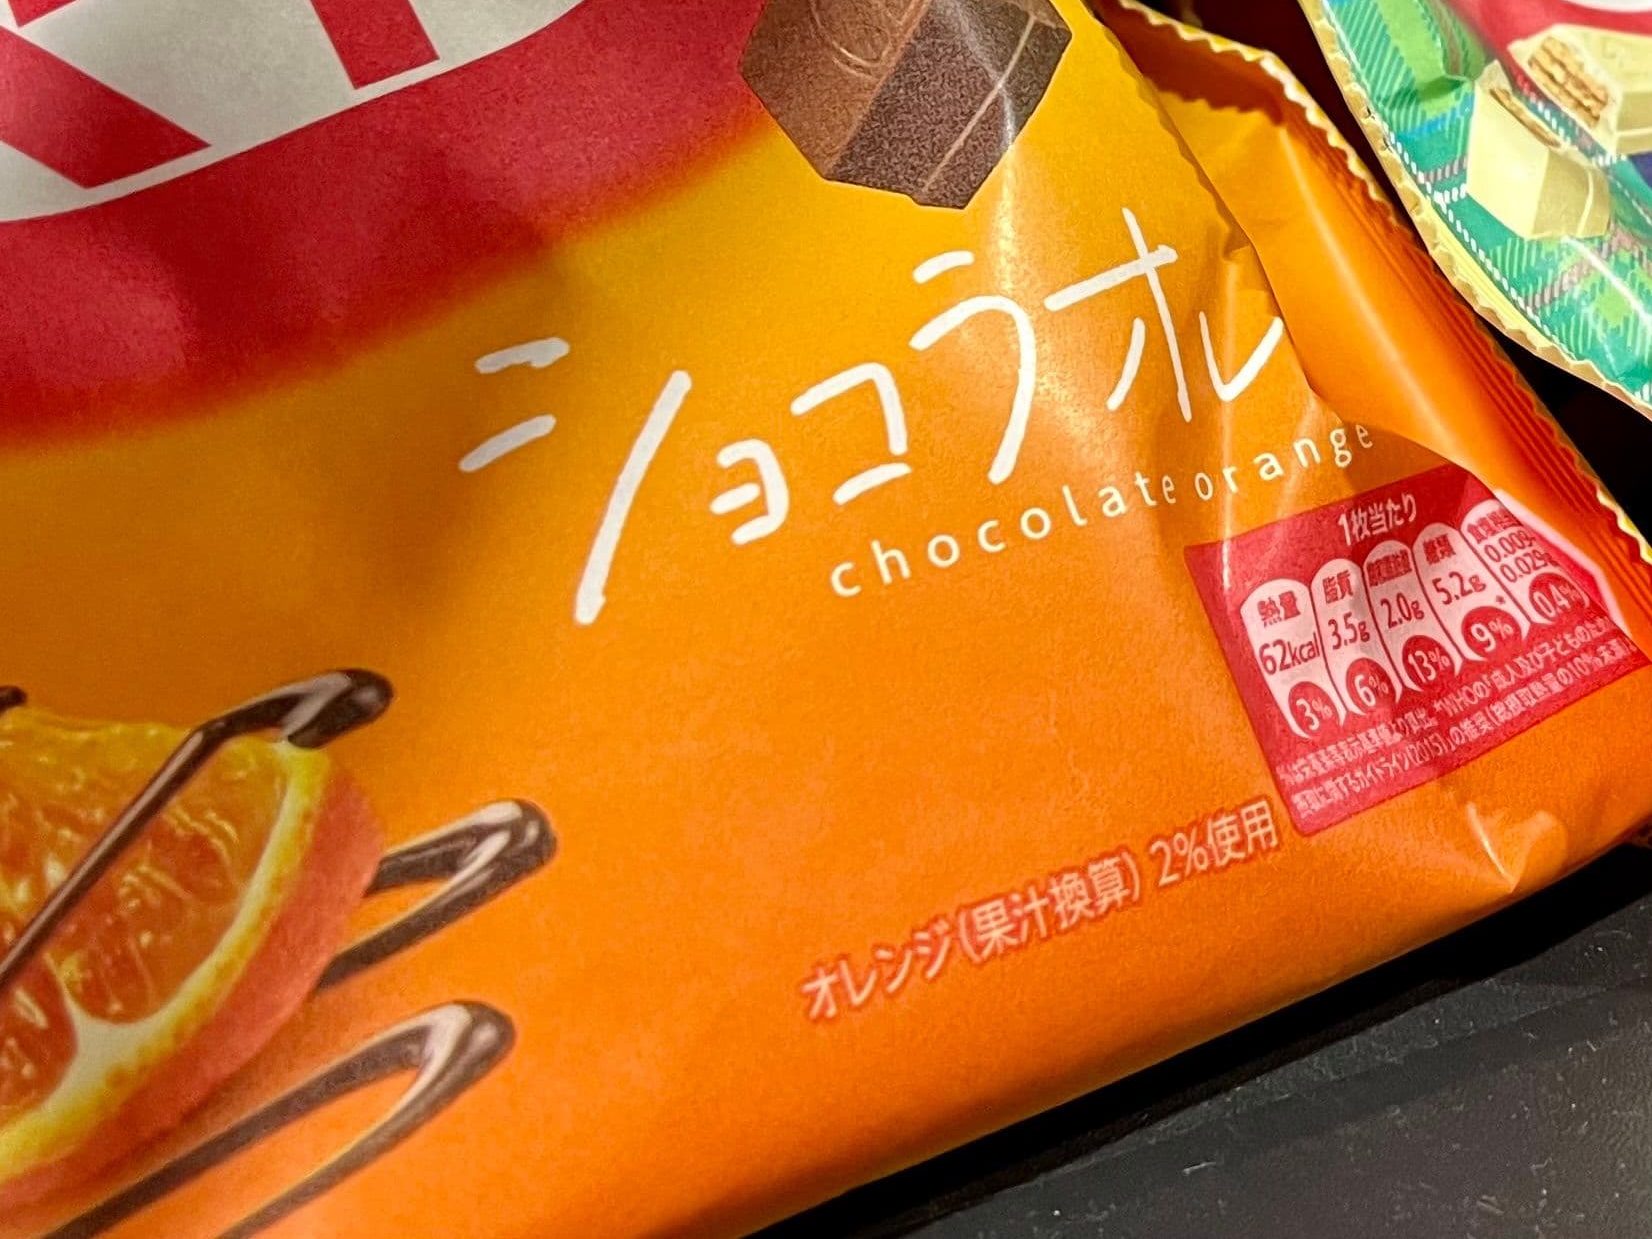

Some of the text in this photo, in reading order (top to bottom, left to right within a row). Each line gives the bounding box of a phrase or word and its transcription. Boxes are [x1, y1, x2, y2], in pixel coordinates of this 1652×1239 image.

[458, 208, 1285, 624] ショコラオレ
[830, 422, 1376, 598] chocolate orange
[1338, 493, 1417, 547] 1枚当たり
[1432, 571, 1486, 606] 5.2g
[1533, 583, 1580, 621] 0.4%
[1380, 592, 1425, 630] 2.0g
[1327, 611, 1371, 650] 3.5g
[1471, 617, 1514, 653] 9%
[1258, 632, 1320, 676] 62kcal
[1408, 647, 1450, 685] 13%
[1354, 673, 1389, 708] 6%
[1296, 696, 1333, 731] 3%
[1148, 800, 1279, 888] 2%使用
